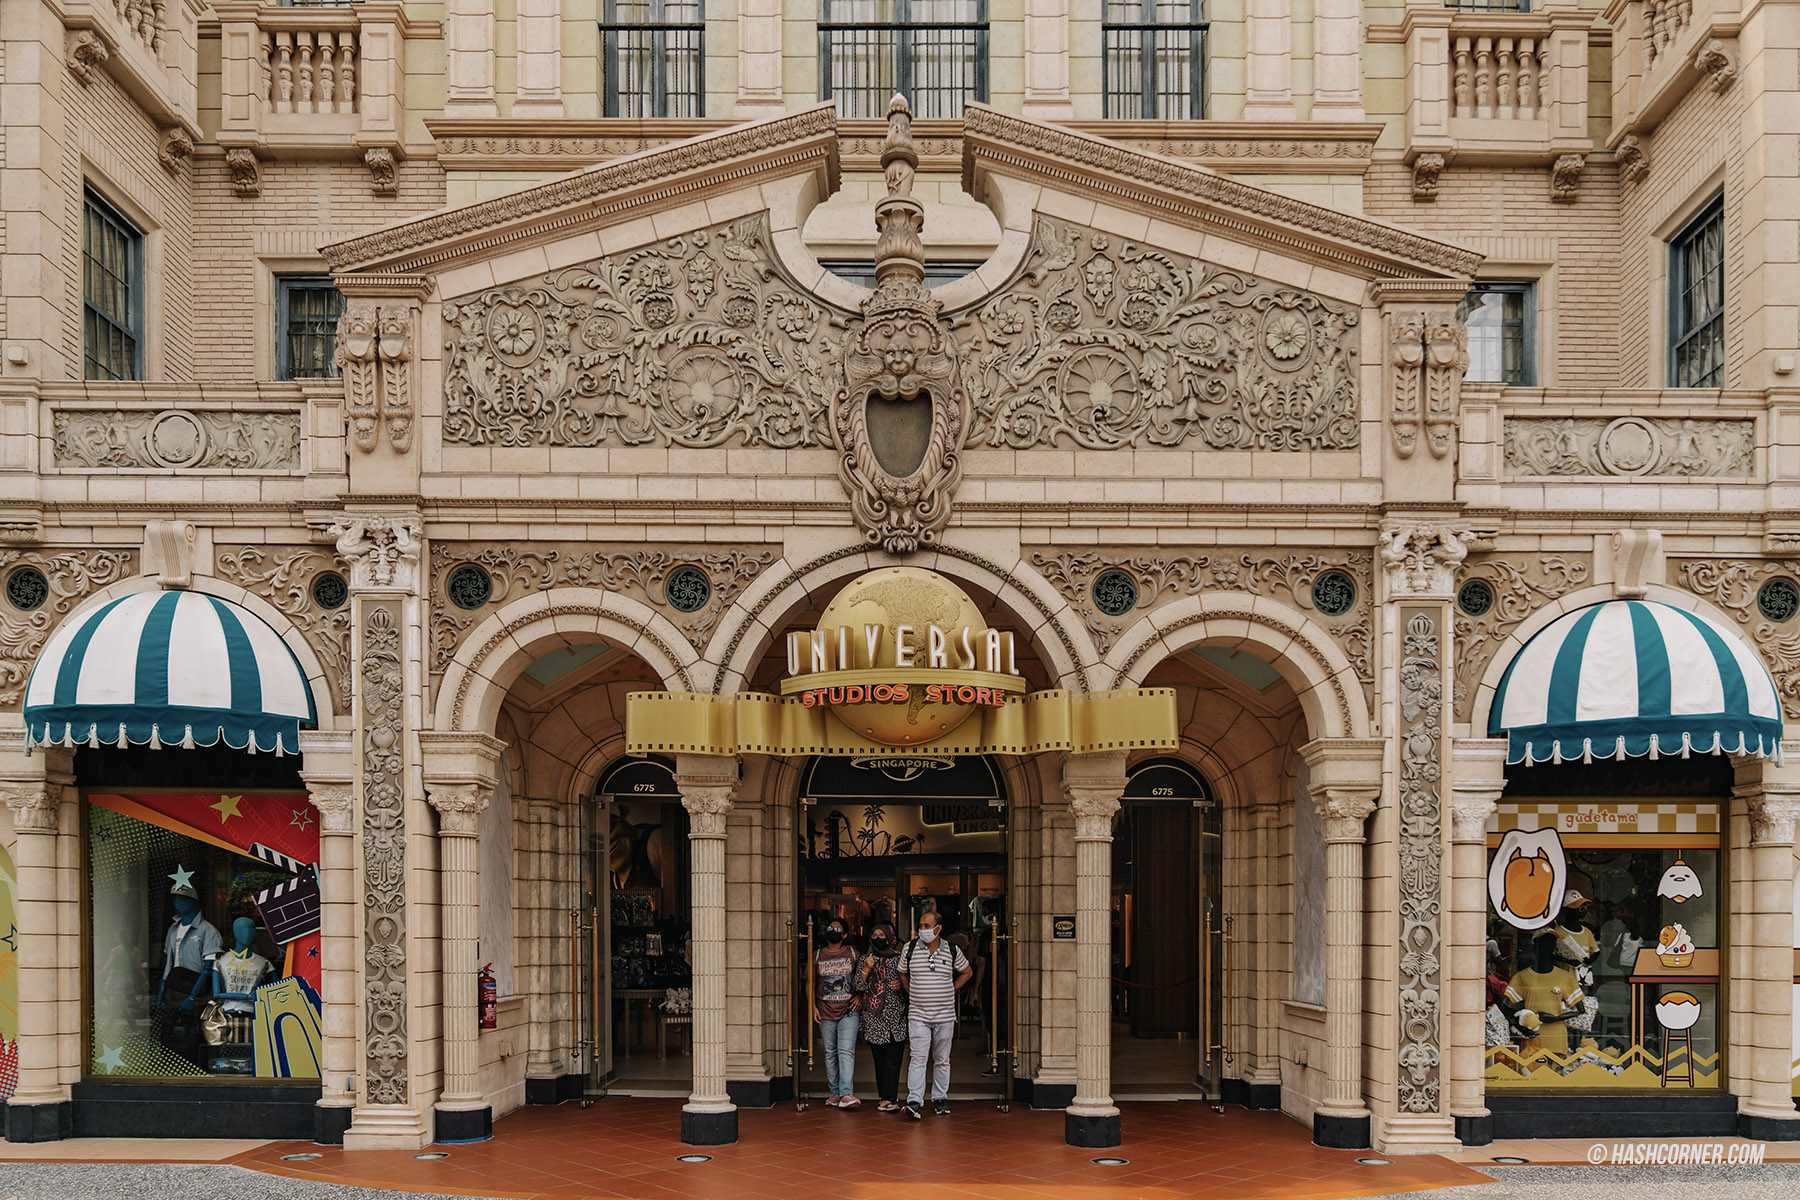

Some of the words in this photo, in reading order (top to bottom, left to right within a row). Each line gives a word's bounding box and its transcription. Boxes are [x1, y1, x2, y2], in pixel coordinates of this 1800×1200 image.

[787, 623, 1020, 676] UNIVERSAL
[802, 684, 909, 708] STUDIOS
[925, 684, 1006, 707] STORE
[869, 759, 938, 769] SINGAPORE
[633, 783, 655, 792] 6775
[1152, 787, 1174, 796] 6775
[1565, 808, 1637, 828] gudetama
